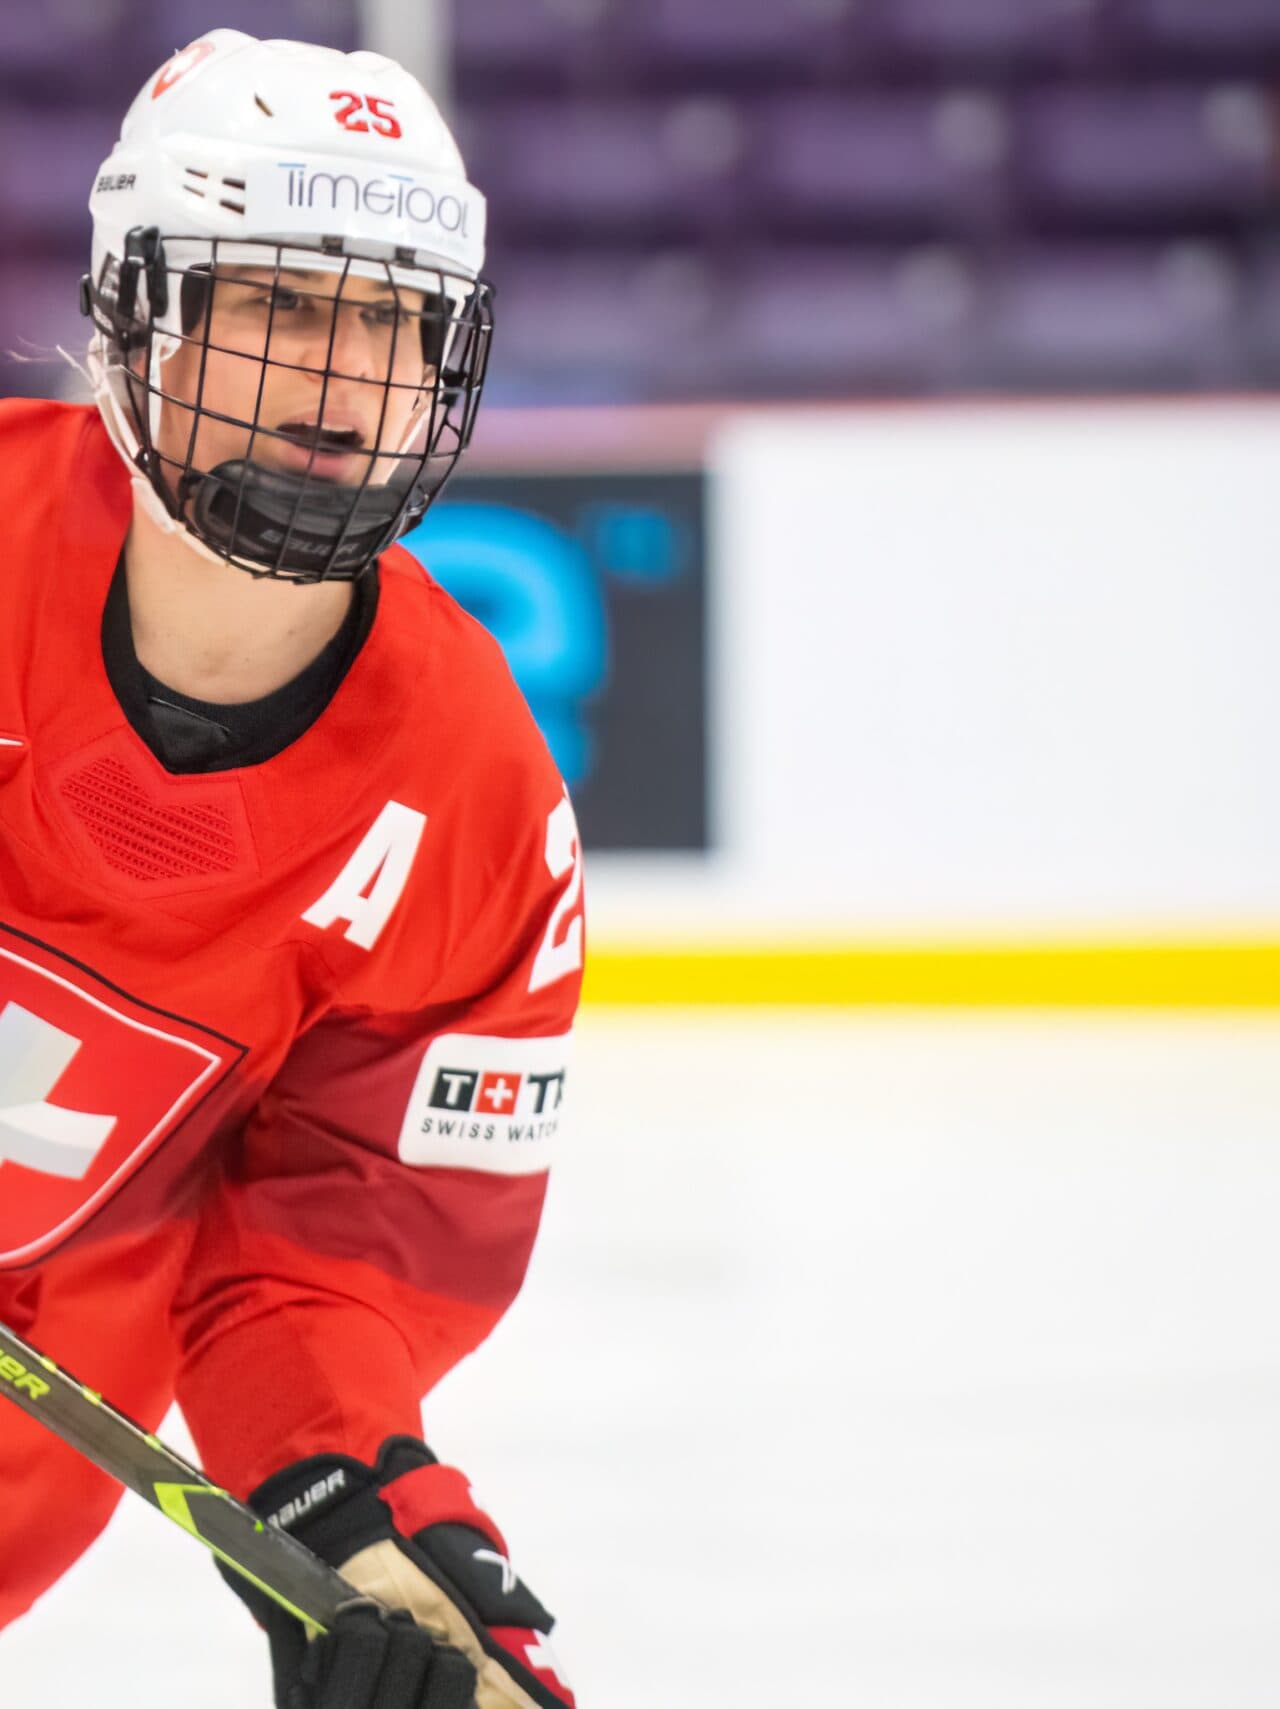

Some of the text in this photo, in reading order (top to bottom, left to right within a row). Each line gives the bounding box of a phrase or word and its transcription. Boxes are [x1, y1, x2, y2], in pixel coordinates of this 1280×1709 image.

[329, 90, 402, 139] 25
[300, 799, 428, 952] A
[420, 1116, 496, 1141] SWISS
